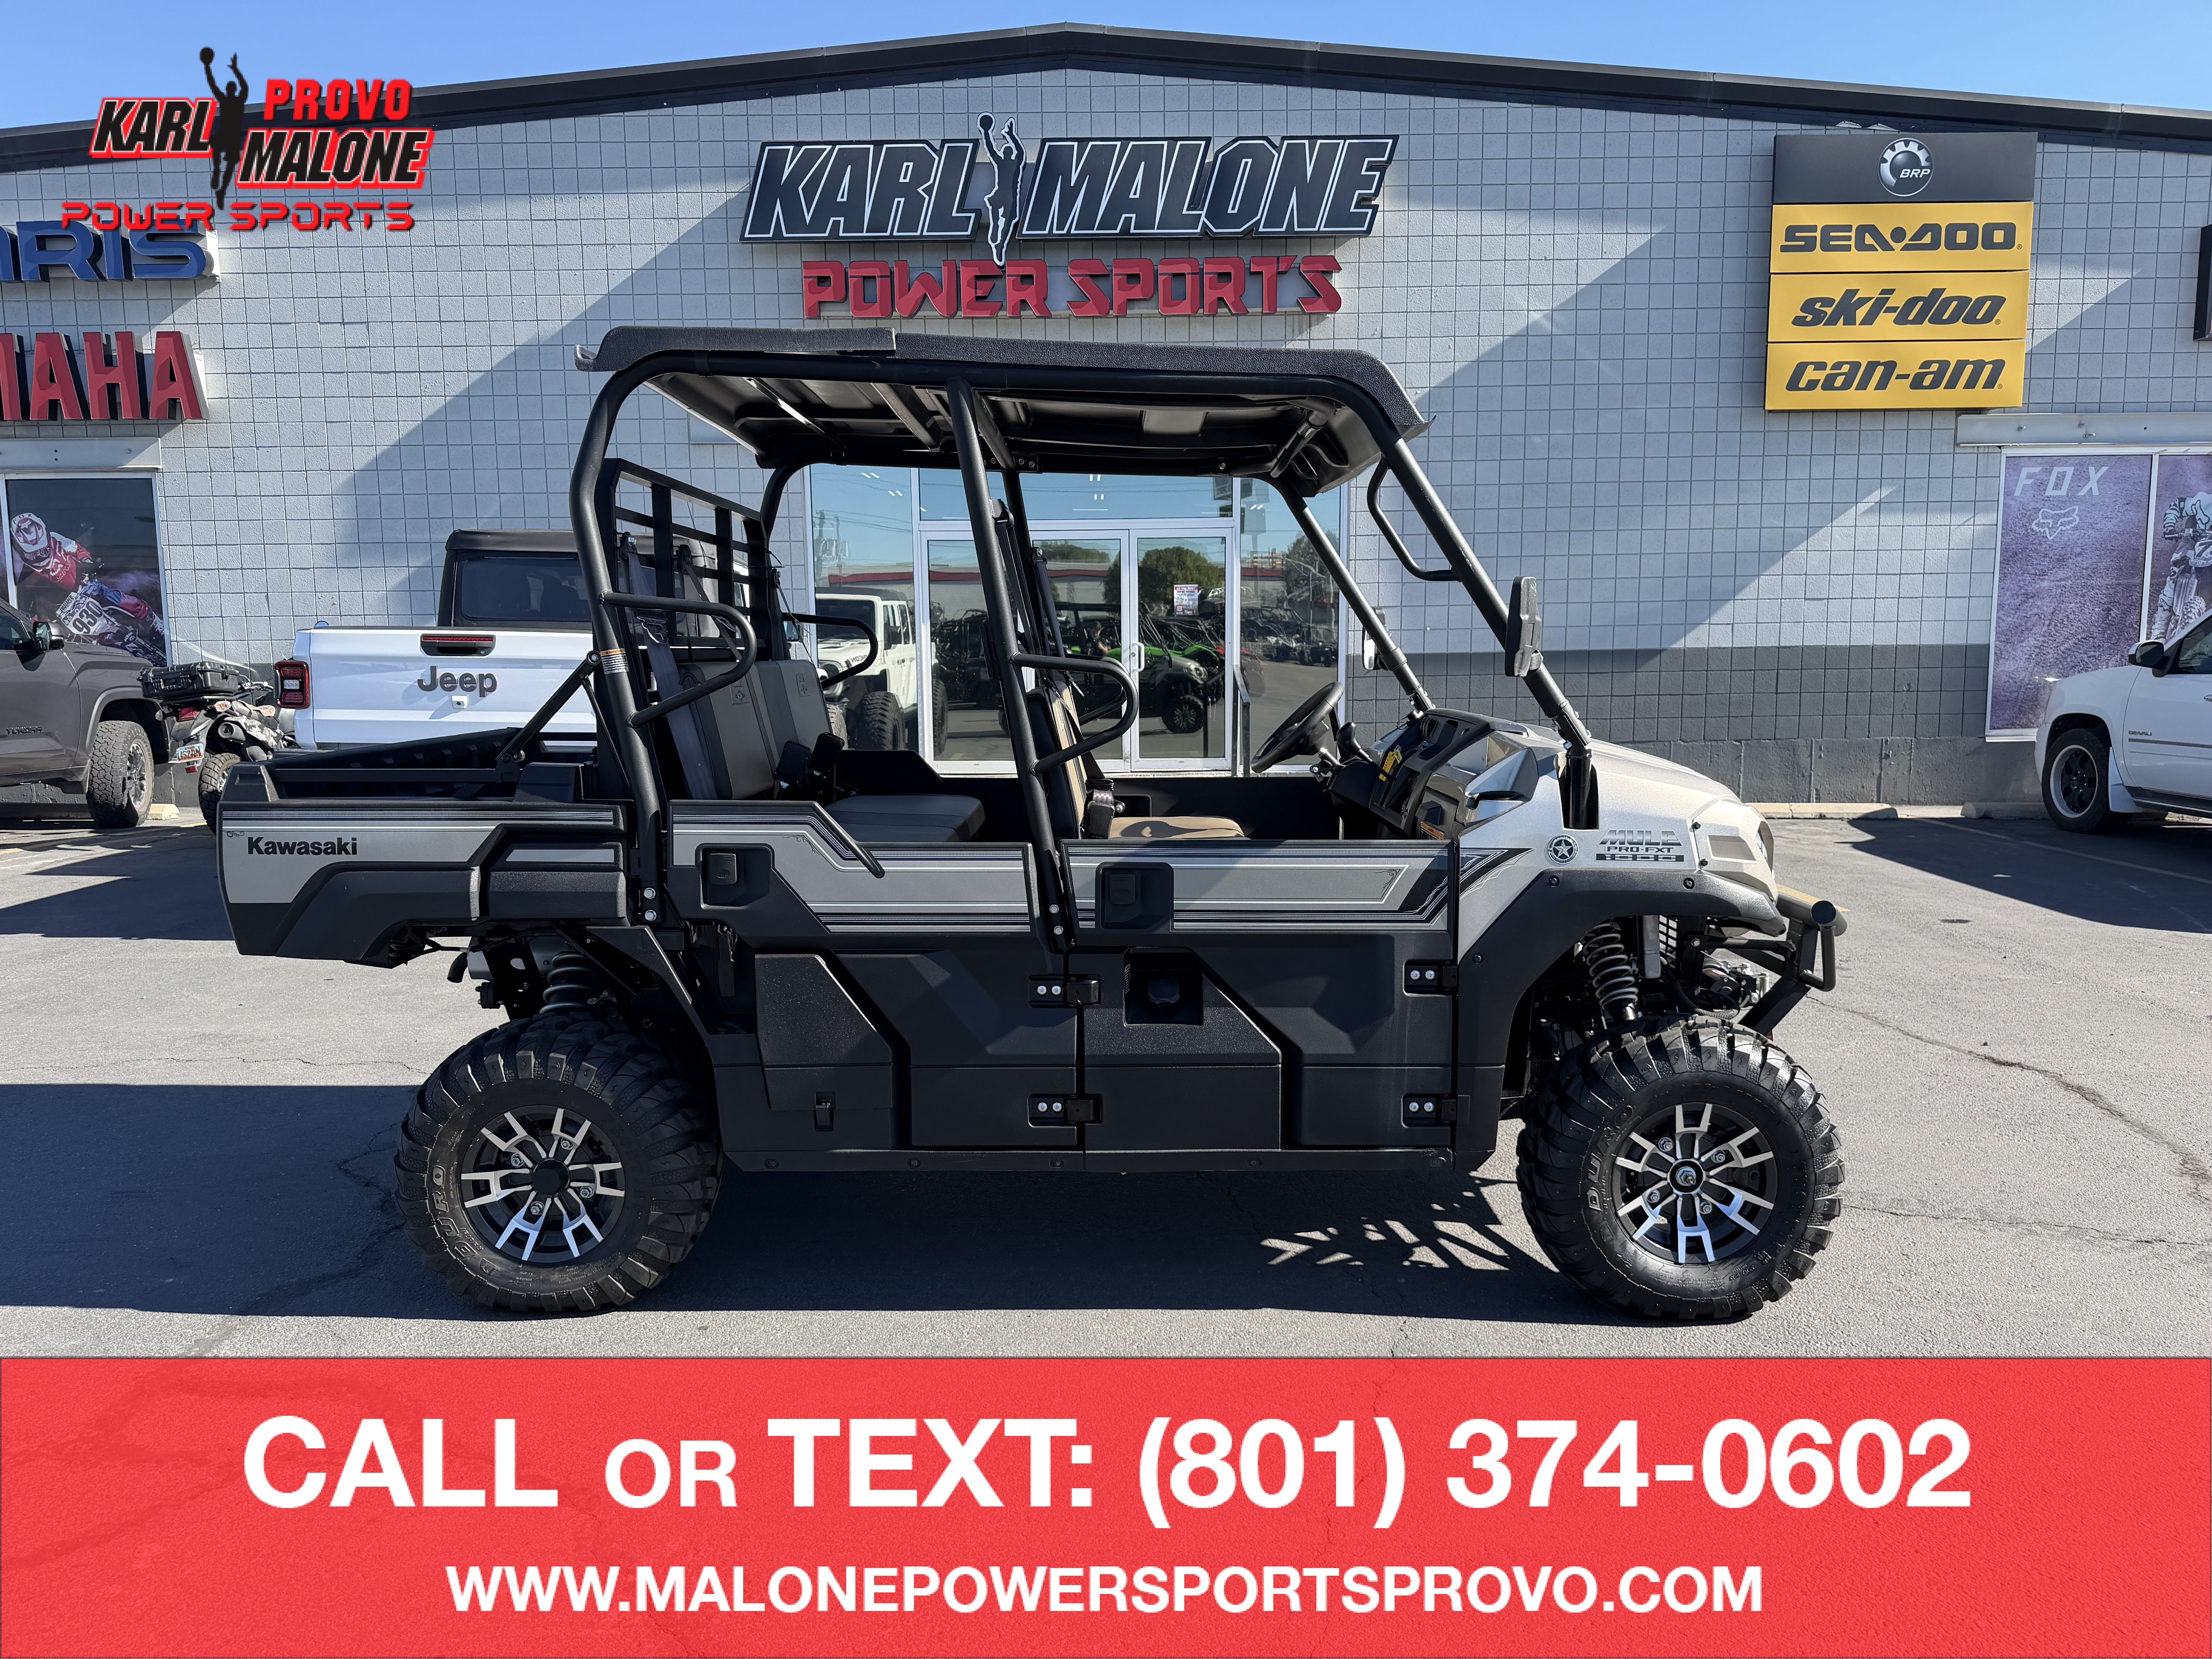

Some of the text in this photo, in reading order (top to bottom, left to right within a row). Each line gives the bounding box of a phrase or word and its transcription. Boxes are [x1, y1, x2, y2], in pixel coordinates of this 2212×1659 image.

[744, 138, 1394, 238] KARL MALONE
[1899, 168, 1931, 178] BRP
[802, 256, 1343, 318] POWER SPORTS
[1792, 288, 2007, 327] ski-doo
[1785, 359, 2006, 392] can-am
[2014, 466, 2109, 496] FOX
[72, 601, 103, 634] 930
[417, 666, 498, 697] Jeep
[248, 837, 357, 855] Kawasaki
[1599, 830, 1682, 846] MULE
[1587, 1105, 1633, 1212] DURO
[432, 1164, 478, 1258] DURO
